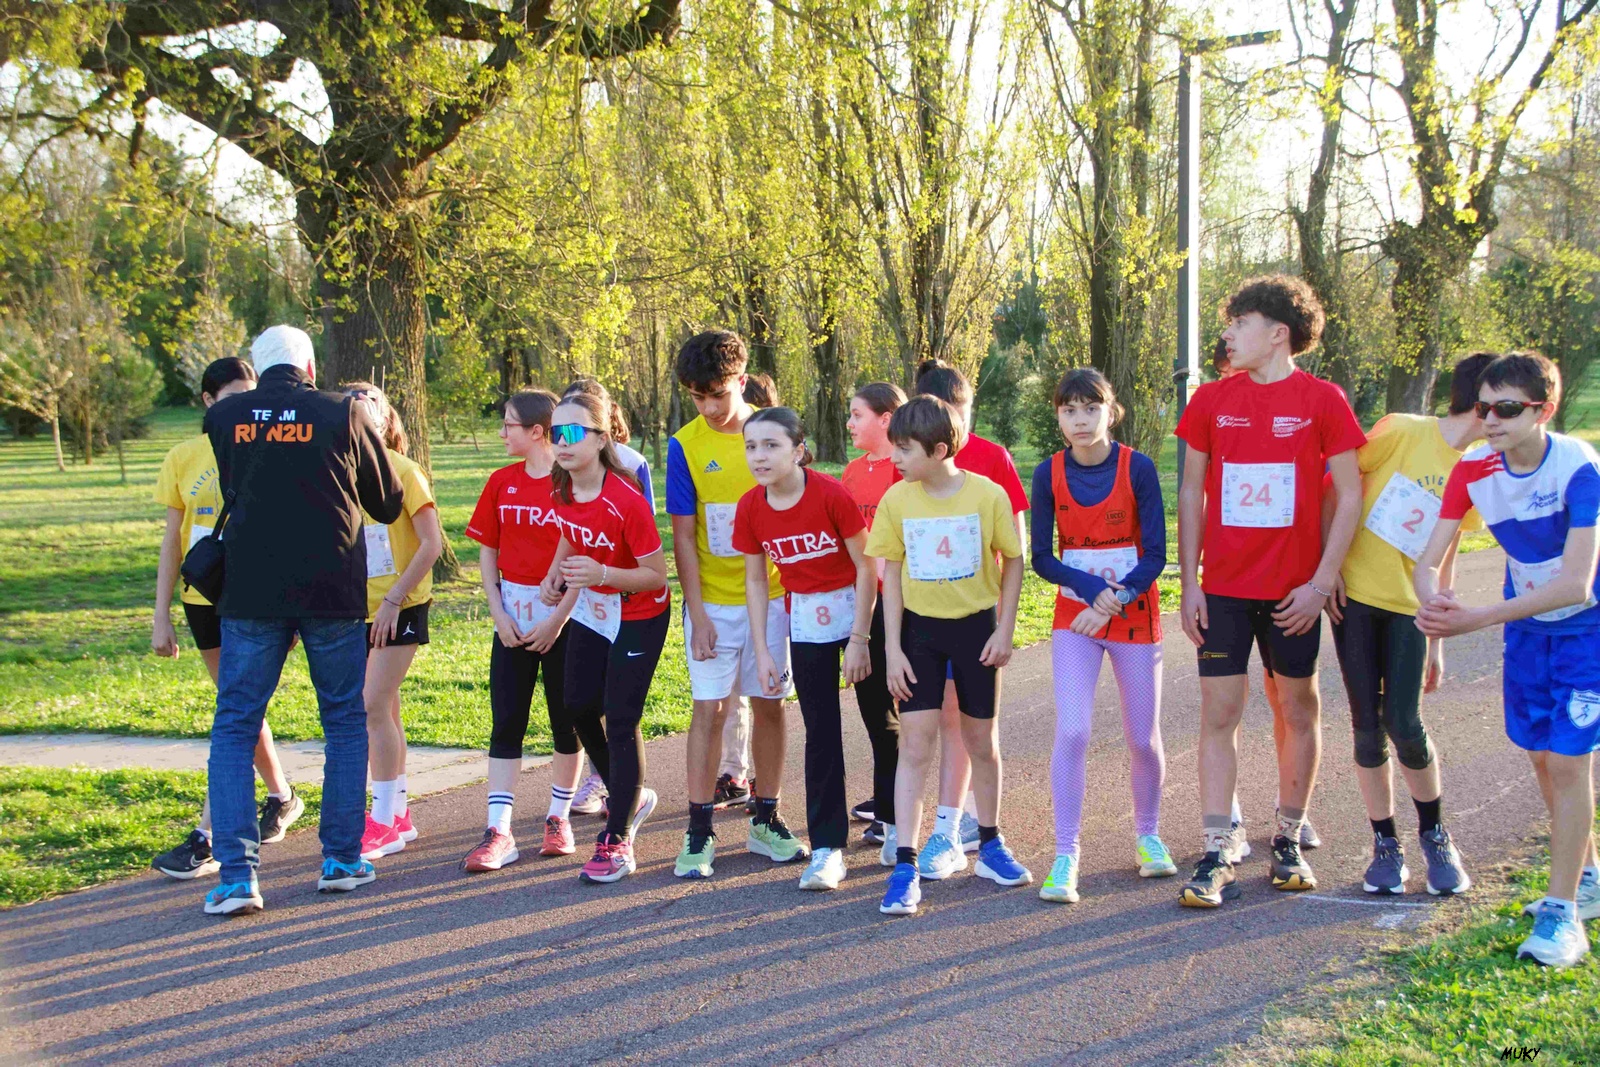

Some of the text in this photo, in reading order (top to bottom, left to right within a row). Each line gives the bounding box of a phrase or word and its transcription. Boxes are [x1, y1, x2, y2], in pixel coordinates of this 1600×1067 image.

[252, 410, 296, 421] TEM
[1239, 482, 1272, 507] 24
[1401, 508, 1425, 535] 2
[936, 535, 953, 559] 4
[513, 600, 533, 622] 11
[594, 602, 608, 621] 5
[815, 605, 832, 627] 8
